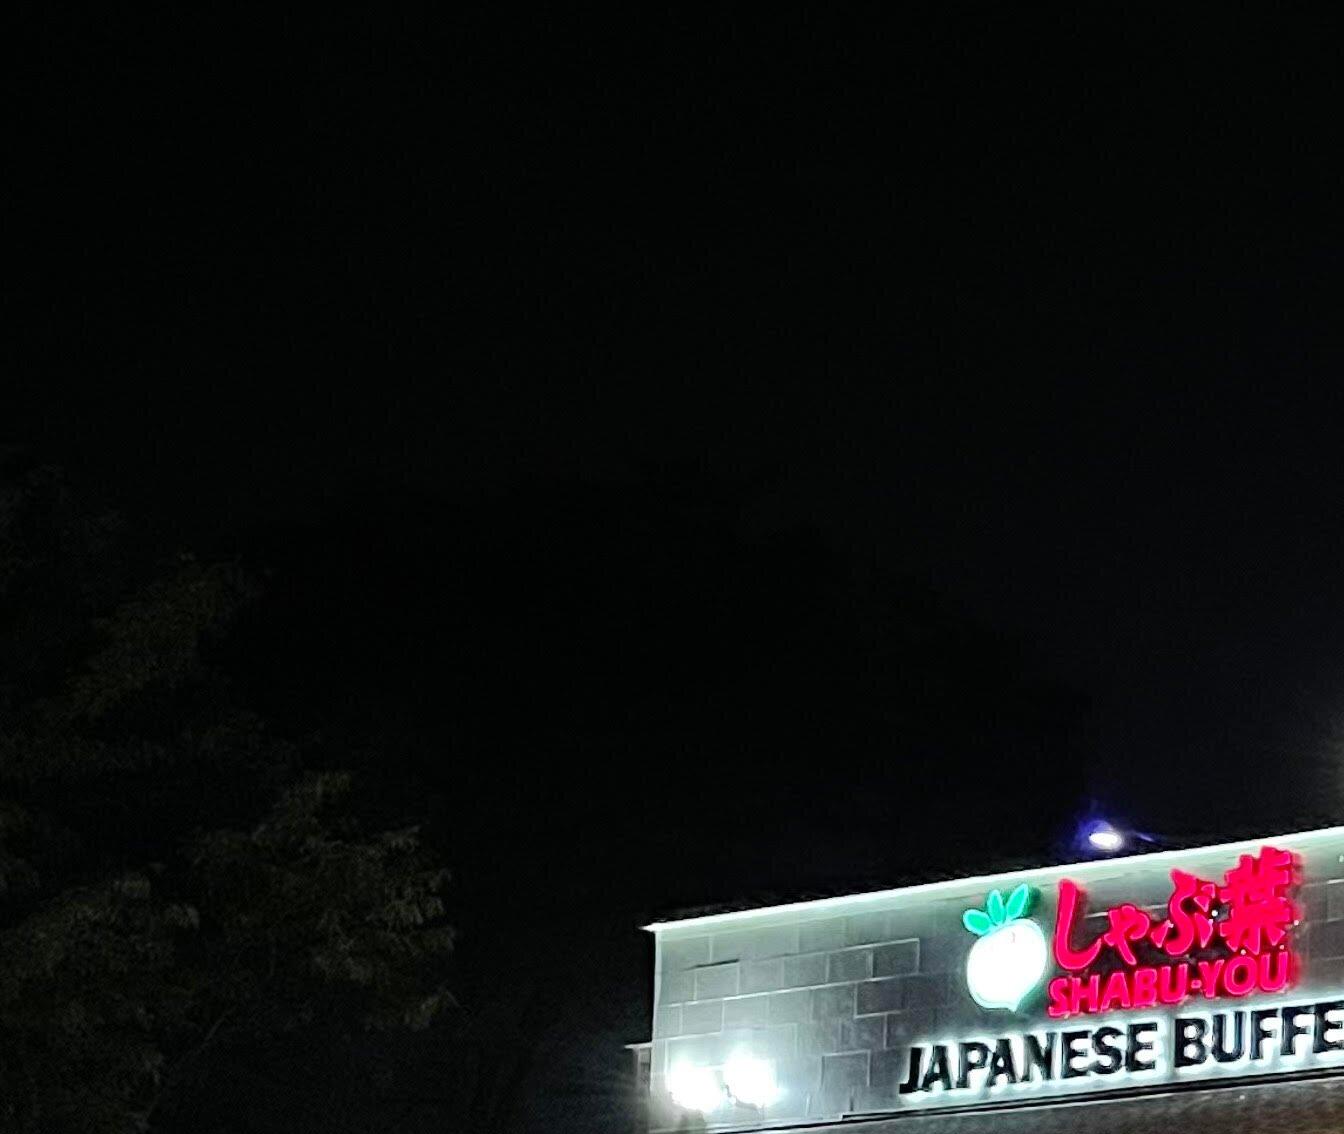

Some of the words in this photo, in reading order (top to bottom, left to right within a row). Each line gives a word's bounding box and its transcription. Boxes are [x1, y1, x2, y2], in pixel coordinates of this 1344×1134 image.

[1053, 846, 1293, 971] しゃぶ葉
[1047, 951, 1289, 1018] SHABU-YOU
[900, 1021, 1158, 1094] JAPANESE
